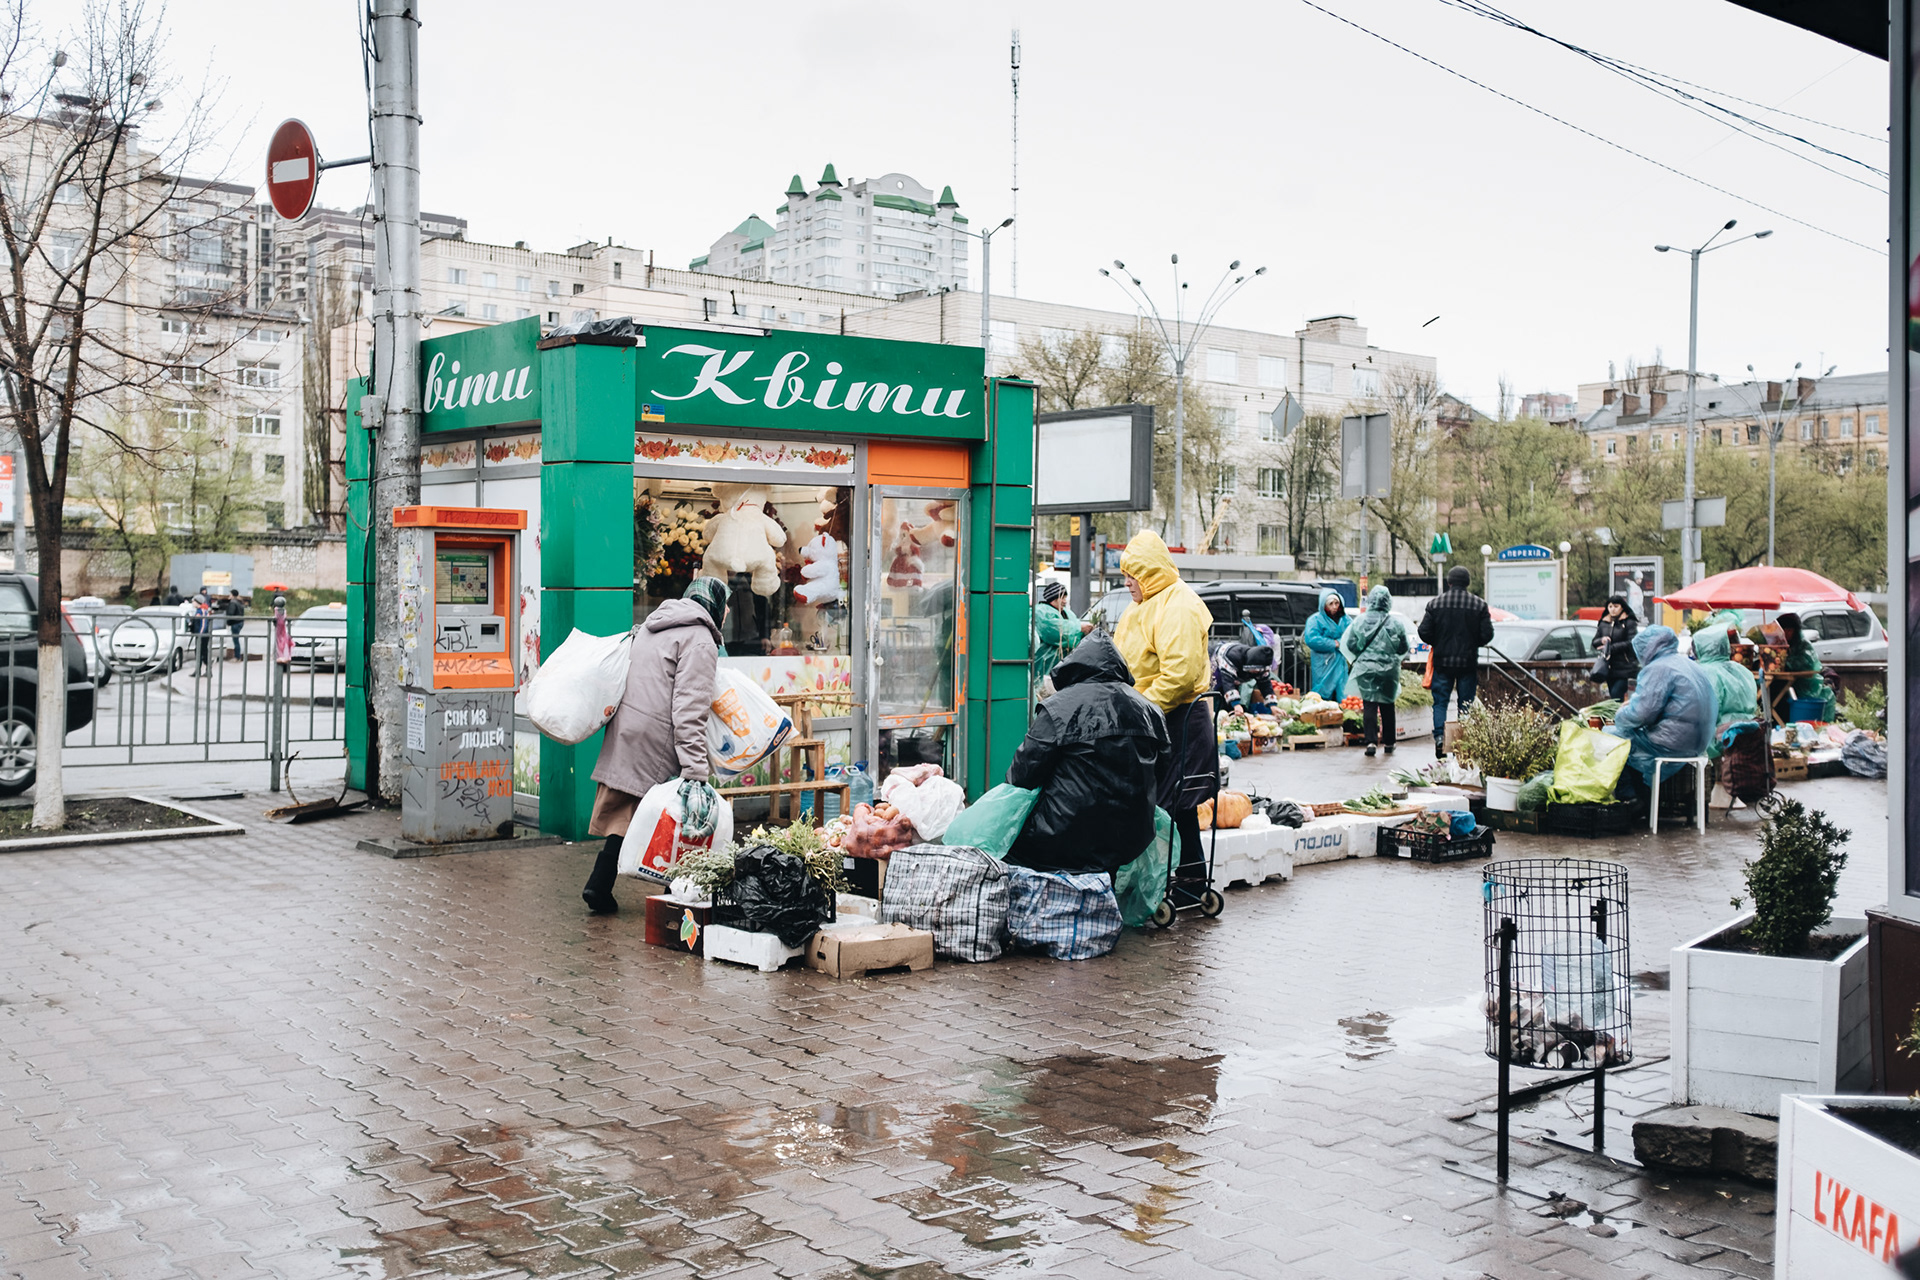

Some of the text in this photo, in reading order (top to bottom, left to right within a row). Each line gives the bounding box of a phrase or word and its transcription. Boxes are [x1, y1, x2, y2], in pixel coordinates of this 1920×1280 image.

[423, 352, 533, 413] віти
[650, 342, 972, 419] Квіти
[1507, 549, 1542, 558] ПЕРЕХІД
[444, 709, 468, 728] СОК
[471, 708, 488, 726] ИЗ
[458, 727, 505, 750] ЛЮДЕЙ
[1813, 1170, 1900, 1265] L'KAFA
